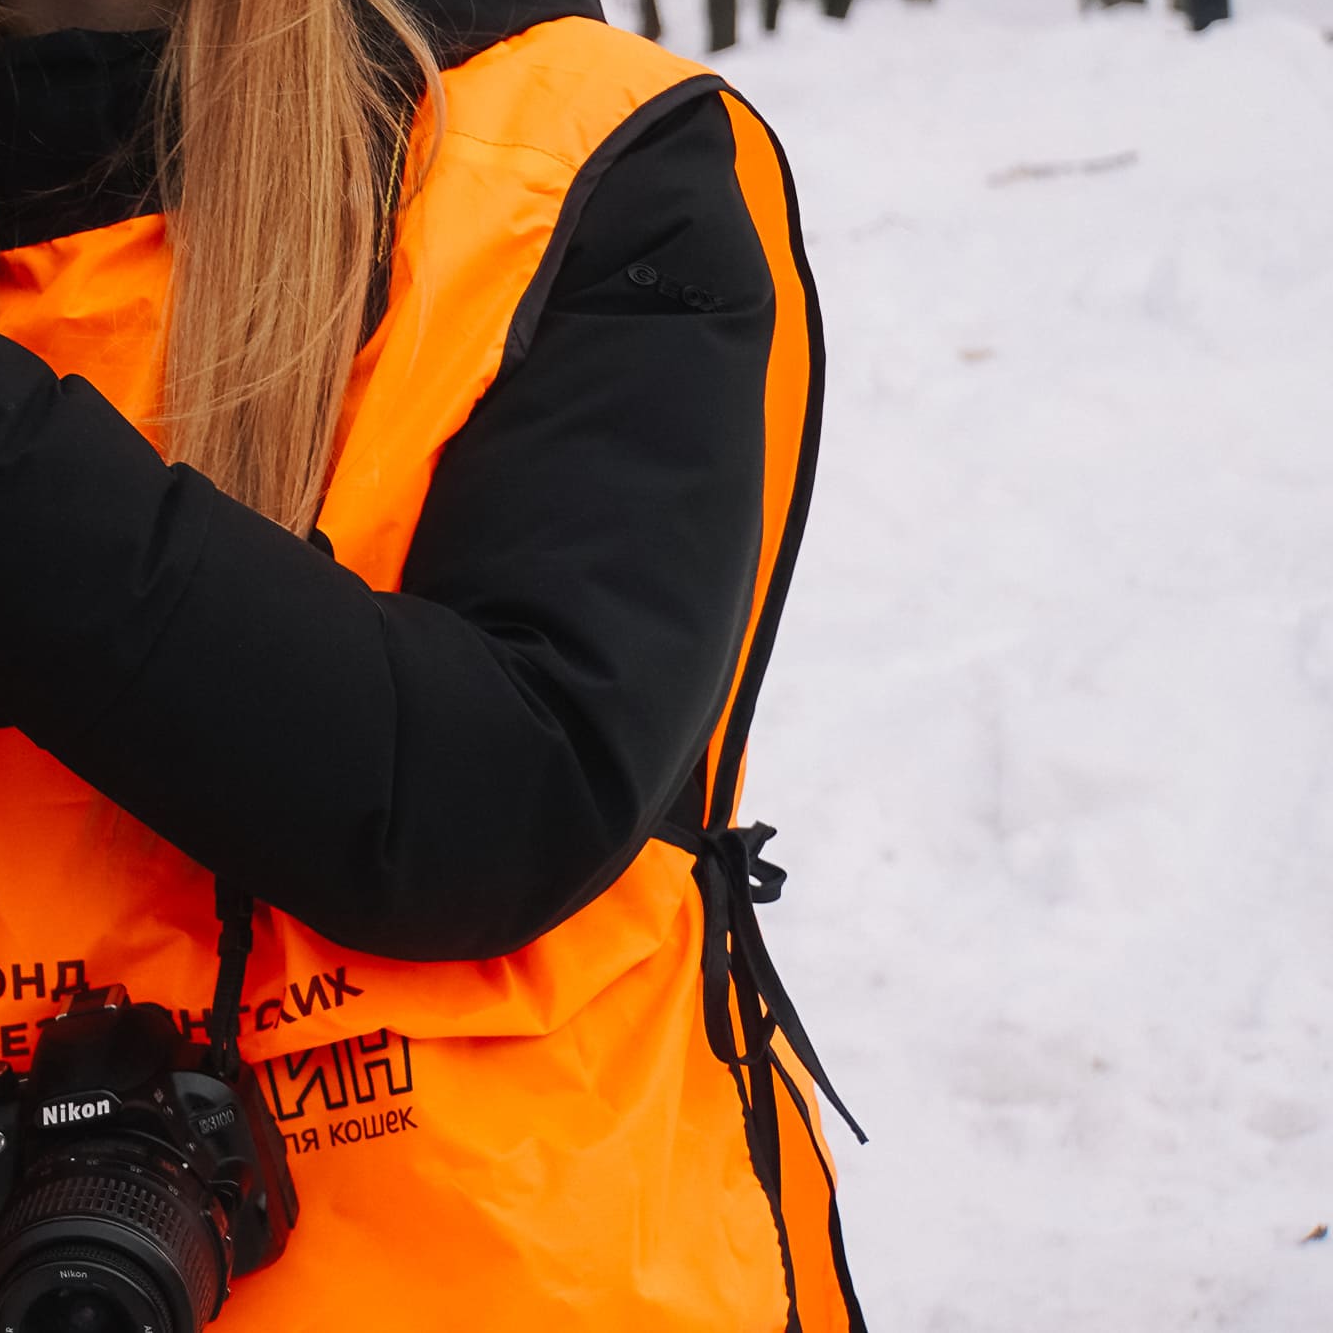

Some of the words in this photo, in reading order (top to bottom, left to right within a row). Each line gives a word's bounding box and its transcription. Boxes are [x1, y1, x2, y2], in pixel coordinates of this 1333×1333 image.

[41, 1097, 111, 1127] Nikon
[198, 1107, 236, 1136] D3100
[329, 1105, 418, 1147] кошек
[59, 1269, 88, 1279] Nikon
